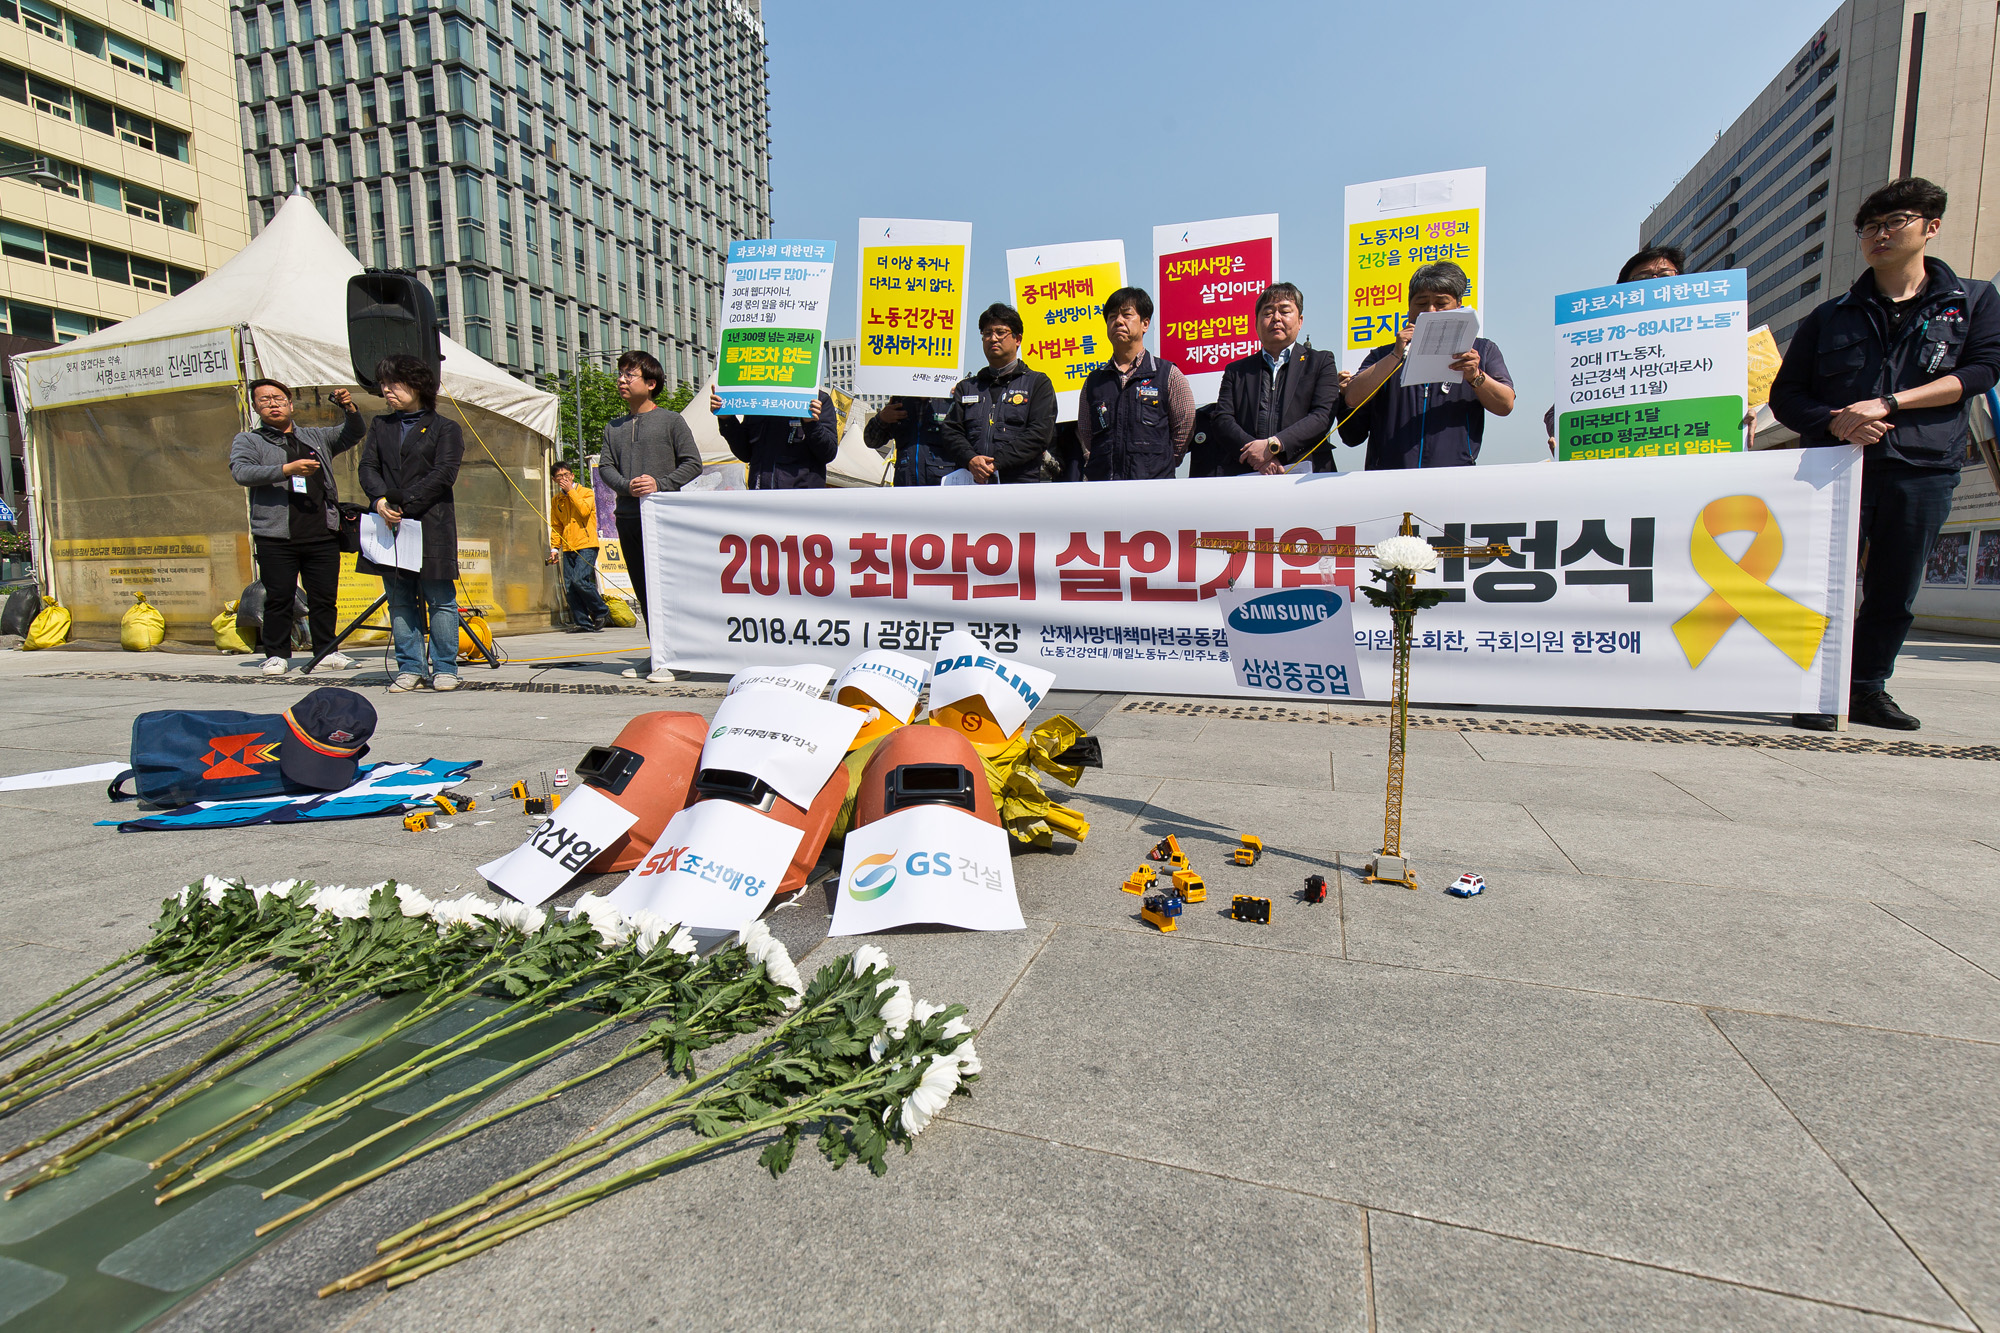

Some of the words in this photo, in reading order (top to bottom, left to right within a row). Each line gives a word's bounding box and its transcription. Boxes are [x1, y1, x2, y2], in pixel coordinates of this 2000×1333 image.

[1358, 225, 1419, 246] 노동자의
[1425, 220, 1470, 239] 생명과
[737, 245, 777, 258] 과로사회
[781, 245, 826, 258] 대한민국
[1358, 249, 1402, 270] 건강을
[1408, 243, 1470, 262] 위협하는
[759, 268, 781, 280] 너무
[878, 256, 888, 270] 더
[892, 256, 913, 270] 이상
[916, 257, 950, 272] 죽거나
[1166, 256, 1245, 281] 산재사망은
[732, 288, 748, 297] 30대
[751, 287, 791, 297] 웹디자이너,
[870, 277, 900, 290] 다치고
[905, 278, 926, 292] 싶지
[930, 279, 955, 293] 않다.
[1022, 278, 1094, 304] 중대재해
[1200, 280, 1265, 304] 살인이다!
[1354, 283, 1402, 307] 위험의
[1570, 288, 1645, 315] 과로사회
[1653, 278, 1731, 303] 대한민국
[731, 301, 742, 310] 4명
[744, 300, 759, 310] 몫의
[762, 300, 777, 309] 일을
[779, 300, 795, 309] 하다
[1044, 305, 1092, 325] 솜방망이
[729, 313, 758, 323] (2018년
[760, 313, 776, 323] 1월)
[867, 307, 954, 330] 노동건강권
[1167, 314, 1248, 340] 기업살인법
[1607, 316, 1693, 341] 78~89시간
[728, 333, 740, 342] 1년
[742, 333, 766, 343] 300명
[768, 332, 785, 343] 넘는
[787, 333, 814, 344] 과로사
[867, 334, 952, 356] 쟁취하자!!!
[1027, 335, 1097, 360] 사법부를
[66, 362, 78, 373] 잊지
[80, 358, 105, 371] 않겠다는
[168, 349, 228, 378] 진실마중대
[726, 347, 780, 364] 통계조차
[782, 347, 811, 364] 없는
[1570, 351, 1601, 368] 20대
[1606, 344, 1665, 362] IT노동자,
[96, 369, 127, 386] 서명으로
[129, 366, 164, 381] 지켜주세요!
[738, 365, 794, 382] 과로자살
[912, 373, 931, 382] 산재는
[934, 374, 957, 382] 살인이다
[1570, 367, 1626, 386] 심근경색
[1630, 358, 1713, 378] 사망(과로사)
[1570, 385, 1625, 404] (2016년
[1629, 380, 1668, 396] 11월)
[1570, 409, 1630, 430] 미국보다
[1634, 407, 1660, 423] 1달
[1570, 432, 1613, 446] OECD
[1618, 425, 1680, 443] 평균보다
[1684, 421, 1710, 437] 2달
[1634, 444, 1660, 457] 4달
[1664, 442, 1680, 455] 더
[1684, 439, 1732, 455] 일하는
[719, 534, 835, 597] 2018
[849, 532, 1036, 600] 최악의
[1056, 526, 1356, 602] 살인기업
[1240, 604, 1328, 622] SAMSUNG
[727, 616, 850, 646] 2018.4.25
[968, 622, 1021, 654] 광장
[1476, 630, 1564, 652] 국회의원
[1571, 630, 1641, 654] 한정애
[934, 654, 1041, 711] DAELIM
[1242, 658, 1350, 696] 삼성중공업
[906, 852, 952, 876] GS
[958, 856, 1003, 892] 건설
